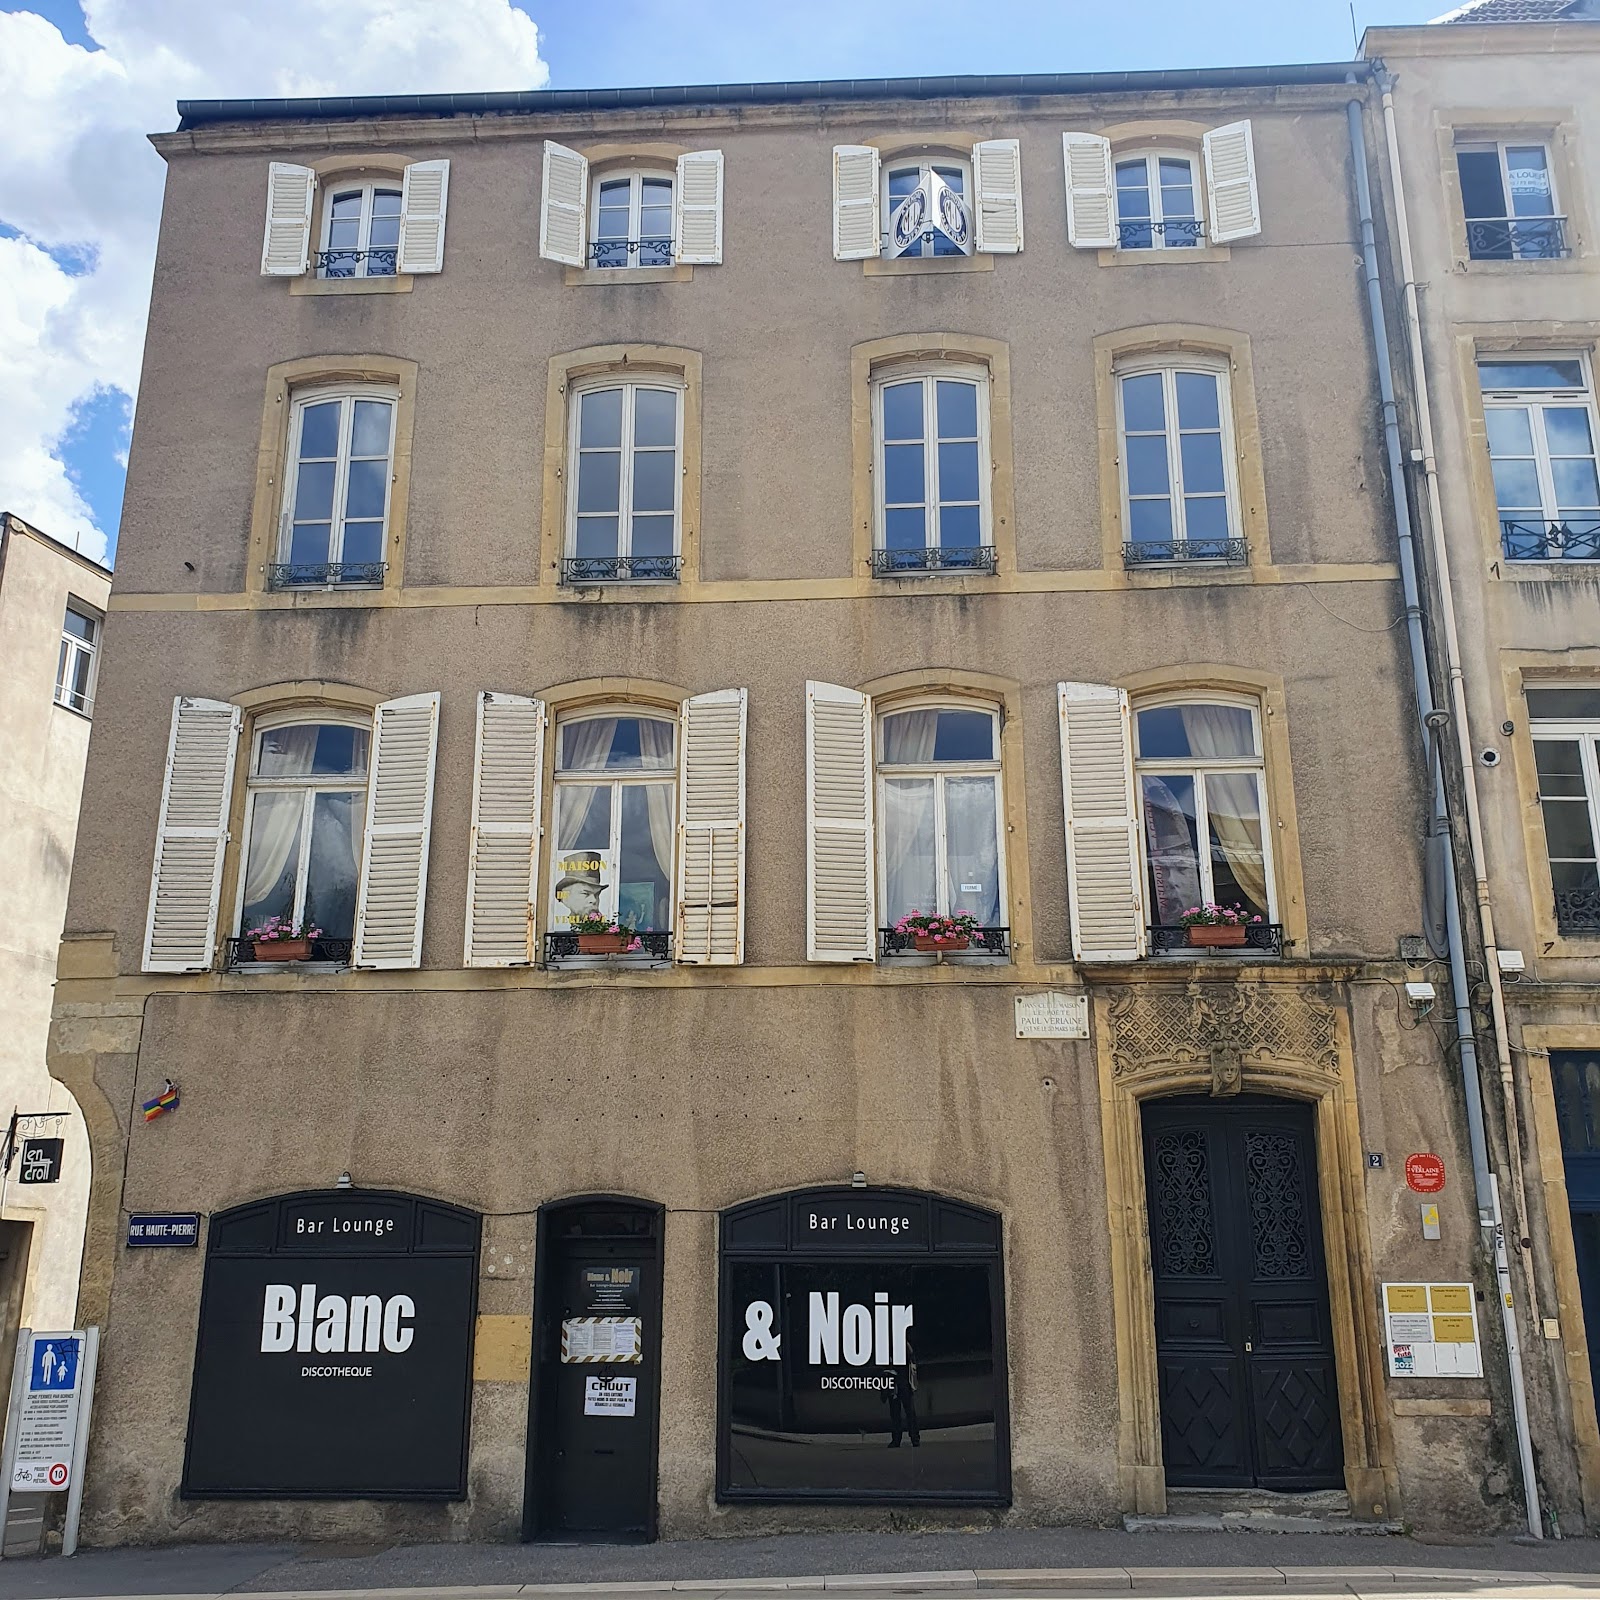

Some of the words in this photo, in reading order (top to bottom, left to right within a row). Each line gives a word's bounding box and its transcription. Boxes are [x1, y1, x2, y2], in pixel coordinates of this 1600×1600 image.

[558, 860, 608, 872] MAISON
[556, 890, 570, 899] DE
[1372, 1155, 1379, 1166] 2
[130, 1225, 144, 1236] RUE
[146, 1224, 195, 1236] HAUTE-PIERRE
[296, 1218, 324, 1233] Bar
[333, 1218, 393, 1236] Lounge
[810, 1214, 837, 1229] Bar
[847, 1214, 909, 1234] Lounge
[611, 1268, 633, 1283] Noir
[260, 1284, 416, 1353] Blanc
[742, 1300, 781, 1361] &
[809, 1292, 913, 1366] Noir
[302, 1367, 372, 1376] DISCOTHEQUE
[592, 1383, 631, 1391] CHUUT
[821, 1377, 894, 1390] DISCOTHEQUE
[55, 1470, 63, 1479] 10
